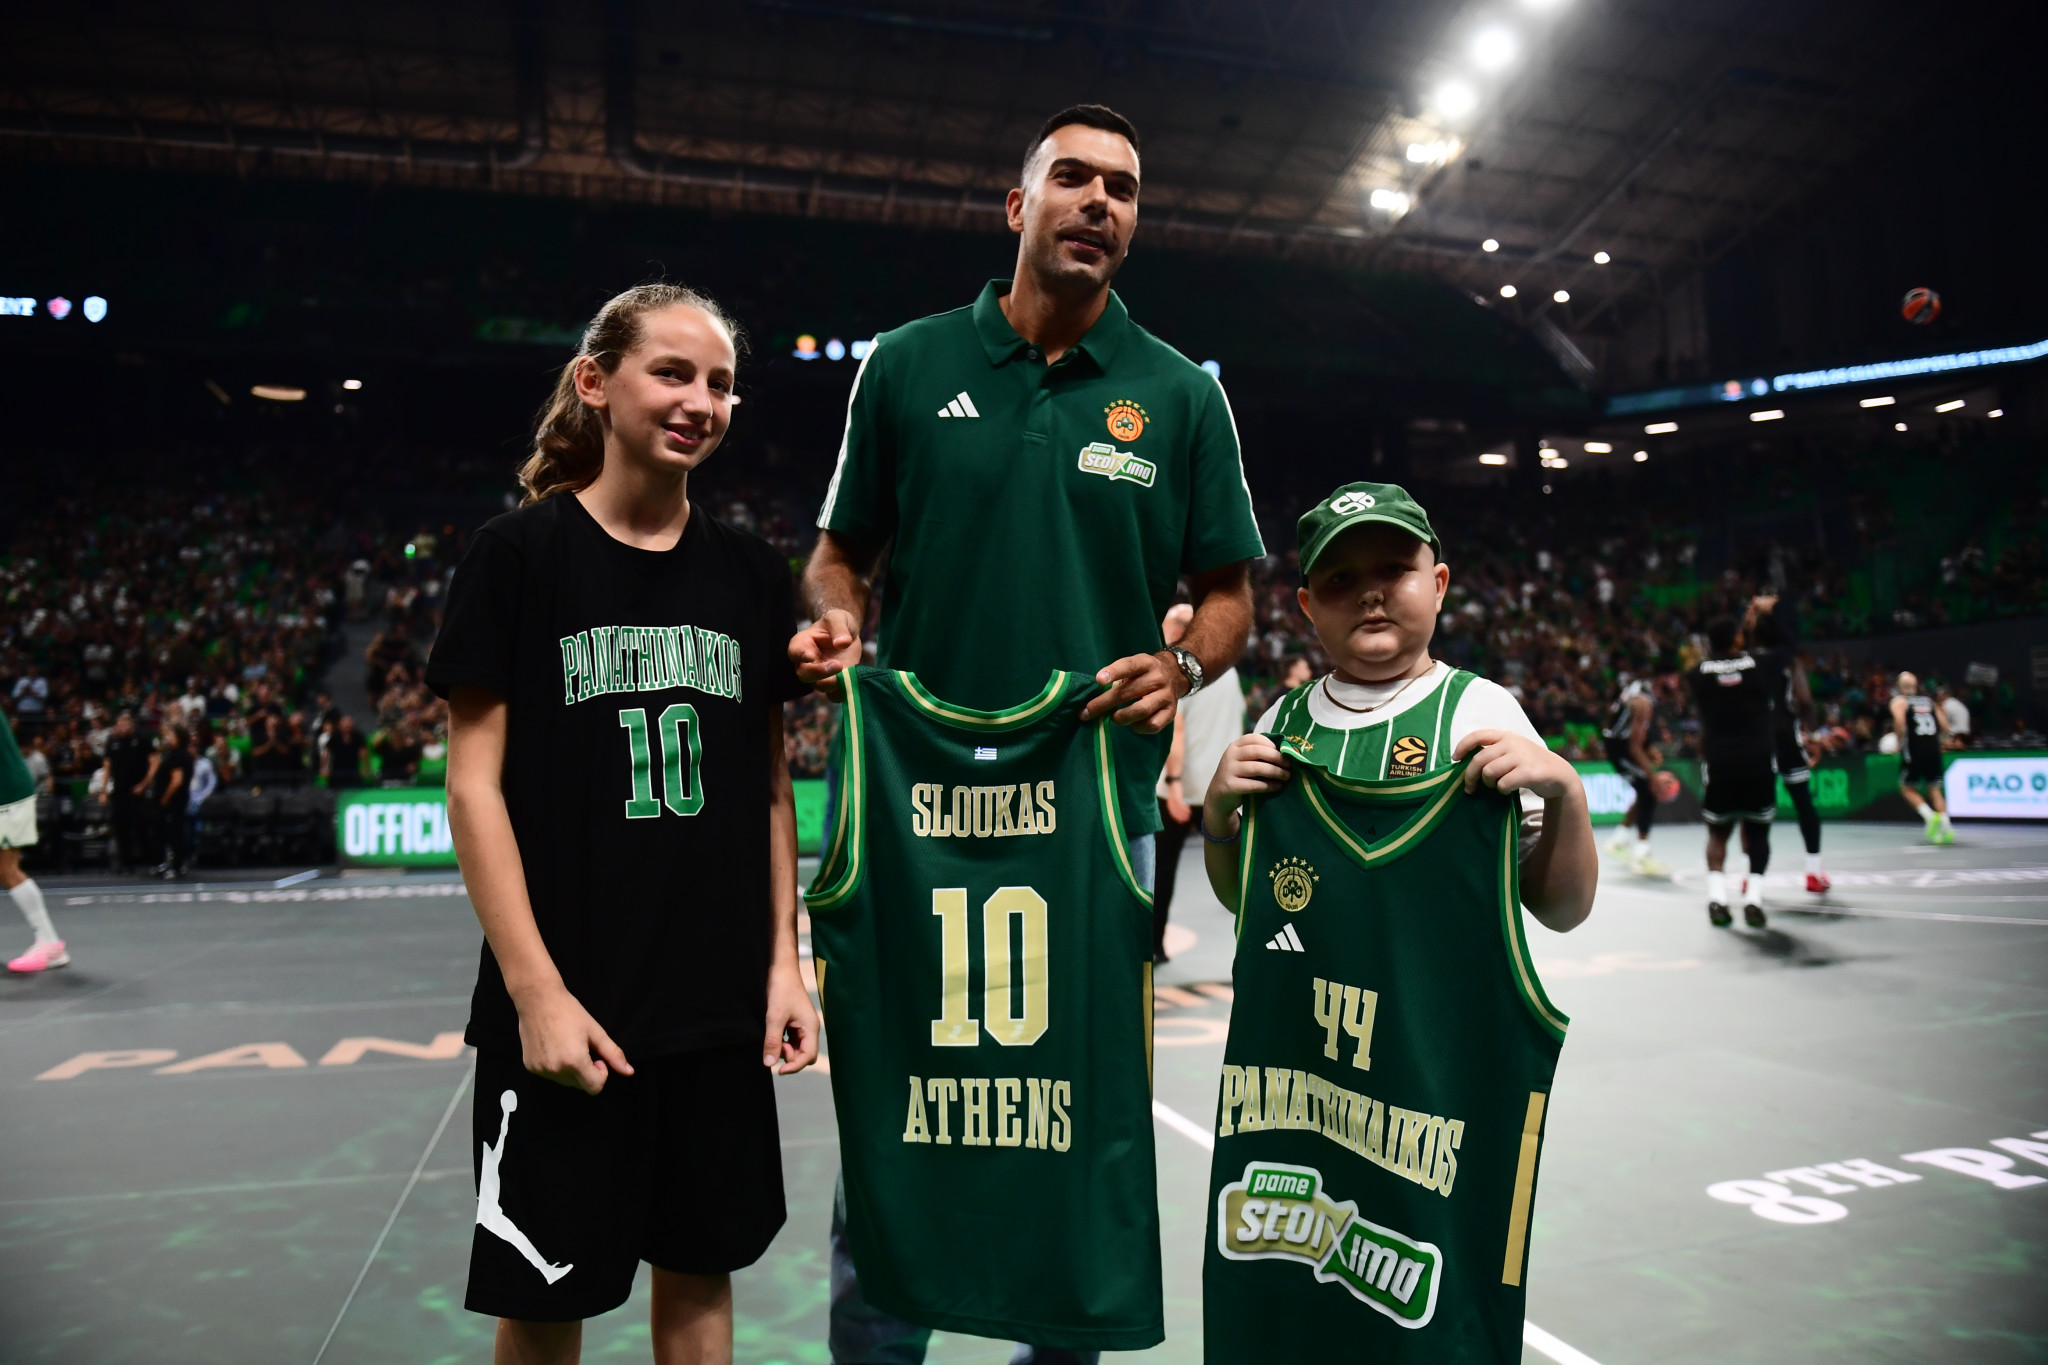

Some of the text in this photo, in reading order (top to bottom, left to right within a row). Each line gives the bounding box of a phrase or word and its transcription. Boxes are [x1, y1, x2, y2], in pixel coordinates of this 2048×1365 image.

[560, 625, 743, 705] PANATHINAIKOS
[619, 704, 705, 819] 10
[1391, 764, 1423, 773] TURKISH
[1968, 774, 2023, 792] PAO
[911, 780, 1056, 838] SLOUKAS
[931, 886, 1049, 1046] 10
[1313, 977, 1379, 1071] 44
[903, 1075, 1071, 1152] ATHENS
[1219, 1064, 1466, 1198] PANATHINAIKOS
[1252, 1173, 1310, 1196] pame
[1706, 1158, 1923, 1224] 8TH
